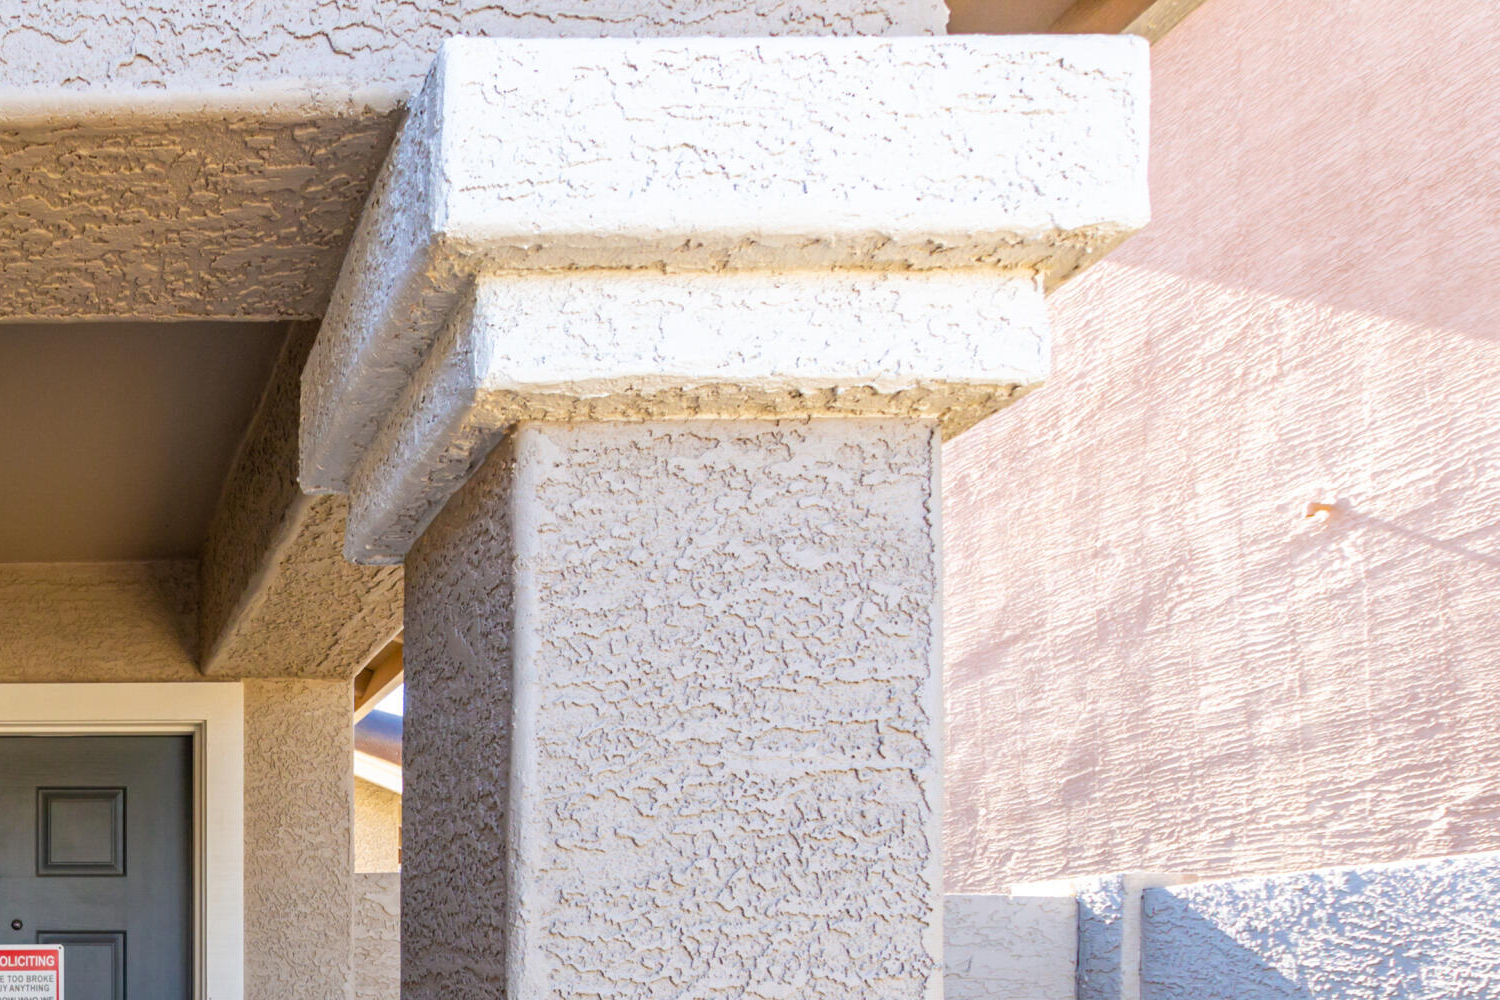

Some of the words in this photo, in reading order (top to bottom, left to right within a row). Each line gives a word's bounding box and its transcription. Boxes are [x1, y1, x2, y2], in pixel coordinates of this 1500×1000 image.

[7, 975, 24, 983] TOO
[26, 975, 54, 983] BROKE
[9, 984, 50, 992] ANYTHING
